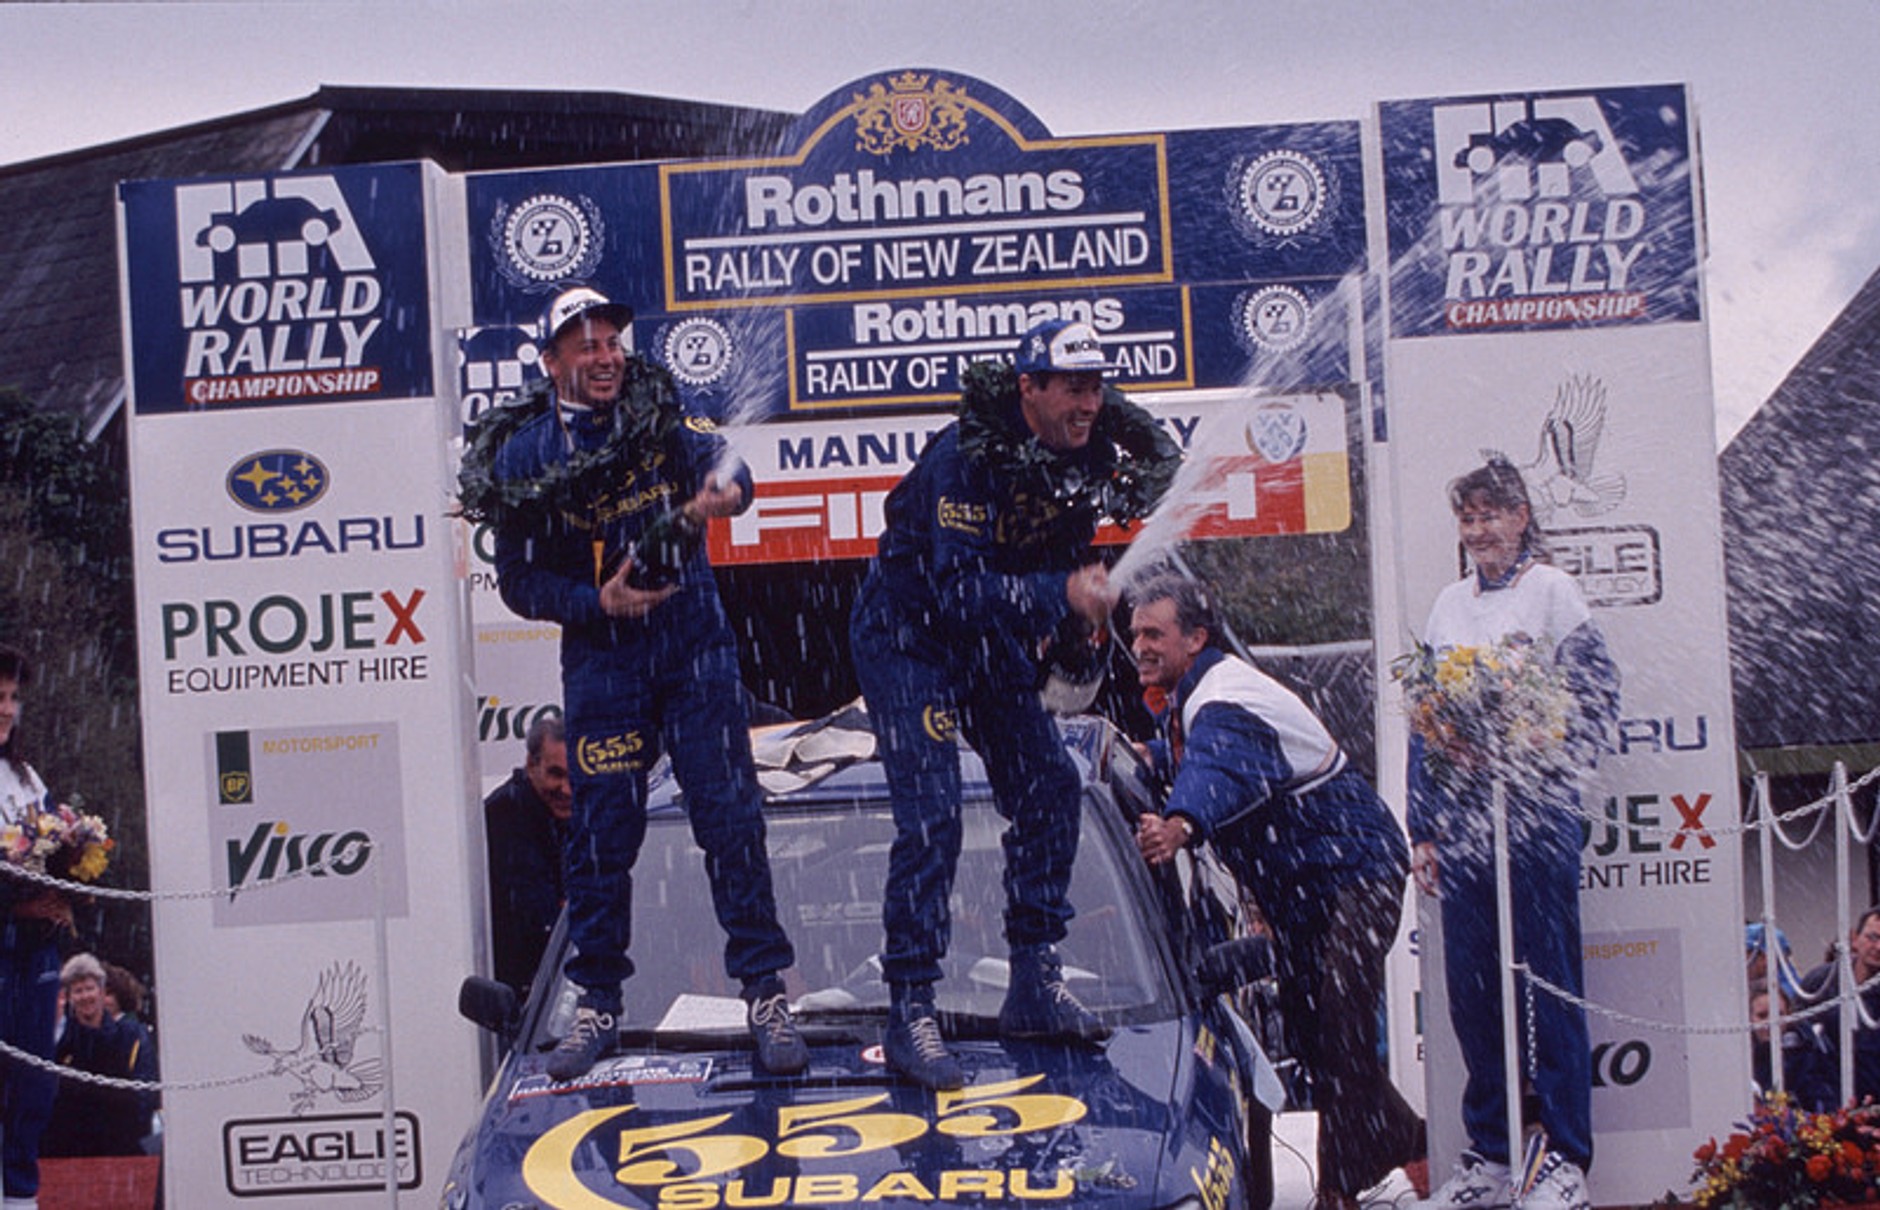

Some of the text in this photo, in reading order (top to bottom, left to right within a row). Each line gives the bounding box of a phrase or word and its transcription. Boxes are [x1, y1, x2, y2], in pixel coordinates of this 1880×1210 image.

[746, 168, 1084, 229] Rothmans
[1439, 199, 1644, 250] WORLD
[686, 227, 1150, 294] RALLY OF NEW ZEALAND
[1444, 242, 1646, 300] RALLY
[181, 275, 381, 329] WORLD
[854, 298, 1126, 344] Rothmans
[1449, 295, 1643, 325] CHAMPIONSHIP
[184, 318, 382, 378] RALLY
[190, 370, 379, 401] CHAMPIONSHIP
[806, 359, 903, 395] RALLY
[906, 356, 948, 389] OF
[778, 430, 937, 471] MANU
[156, 514, 425, 564] SUBARU
[160, 588, 427, 661] PROJEX
[168, 655, 429, 695] EQUIPMENT HIRE
[262, 733, 380, 755] MOTORSPORT
[585, 730, 643, 763] 555
[226, 778, 246, 794] BP
[1639, 858, 1711, 886] HIRE
[239, 1129, 408, 1166] EAGLE
[614, 1073, 1088, 1186] 555
[657, 1168, 1074, 1210] SUBARU
